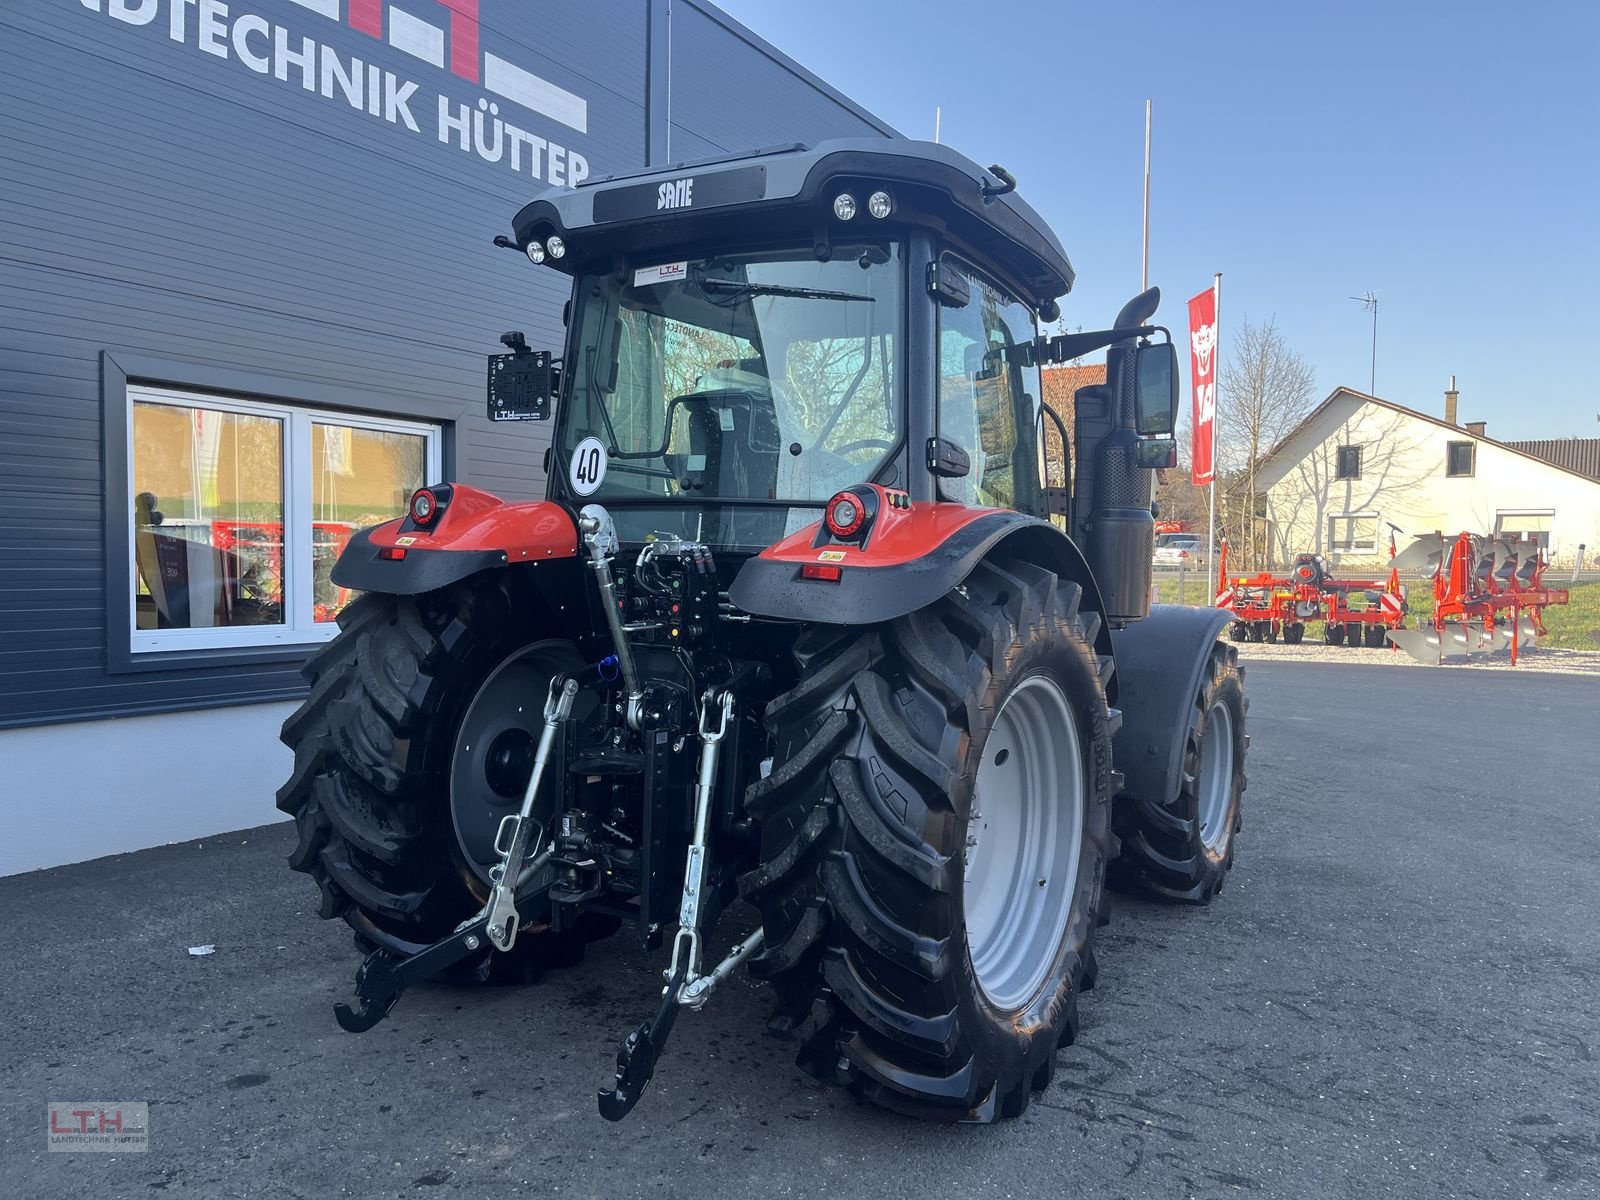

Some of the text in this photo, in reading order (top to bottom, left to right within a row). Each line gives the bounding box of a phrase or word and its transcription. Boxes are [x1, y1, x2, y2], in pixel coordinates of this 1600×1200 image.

[80, 0, 421, 133] TECHNIK
[657, 178, 693, 210] SAME
[660, 264, 680, 276] LTH
[494, 410, 515, 420] LTH
[576, 447, 600, 485] 40
